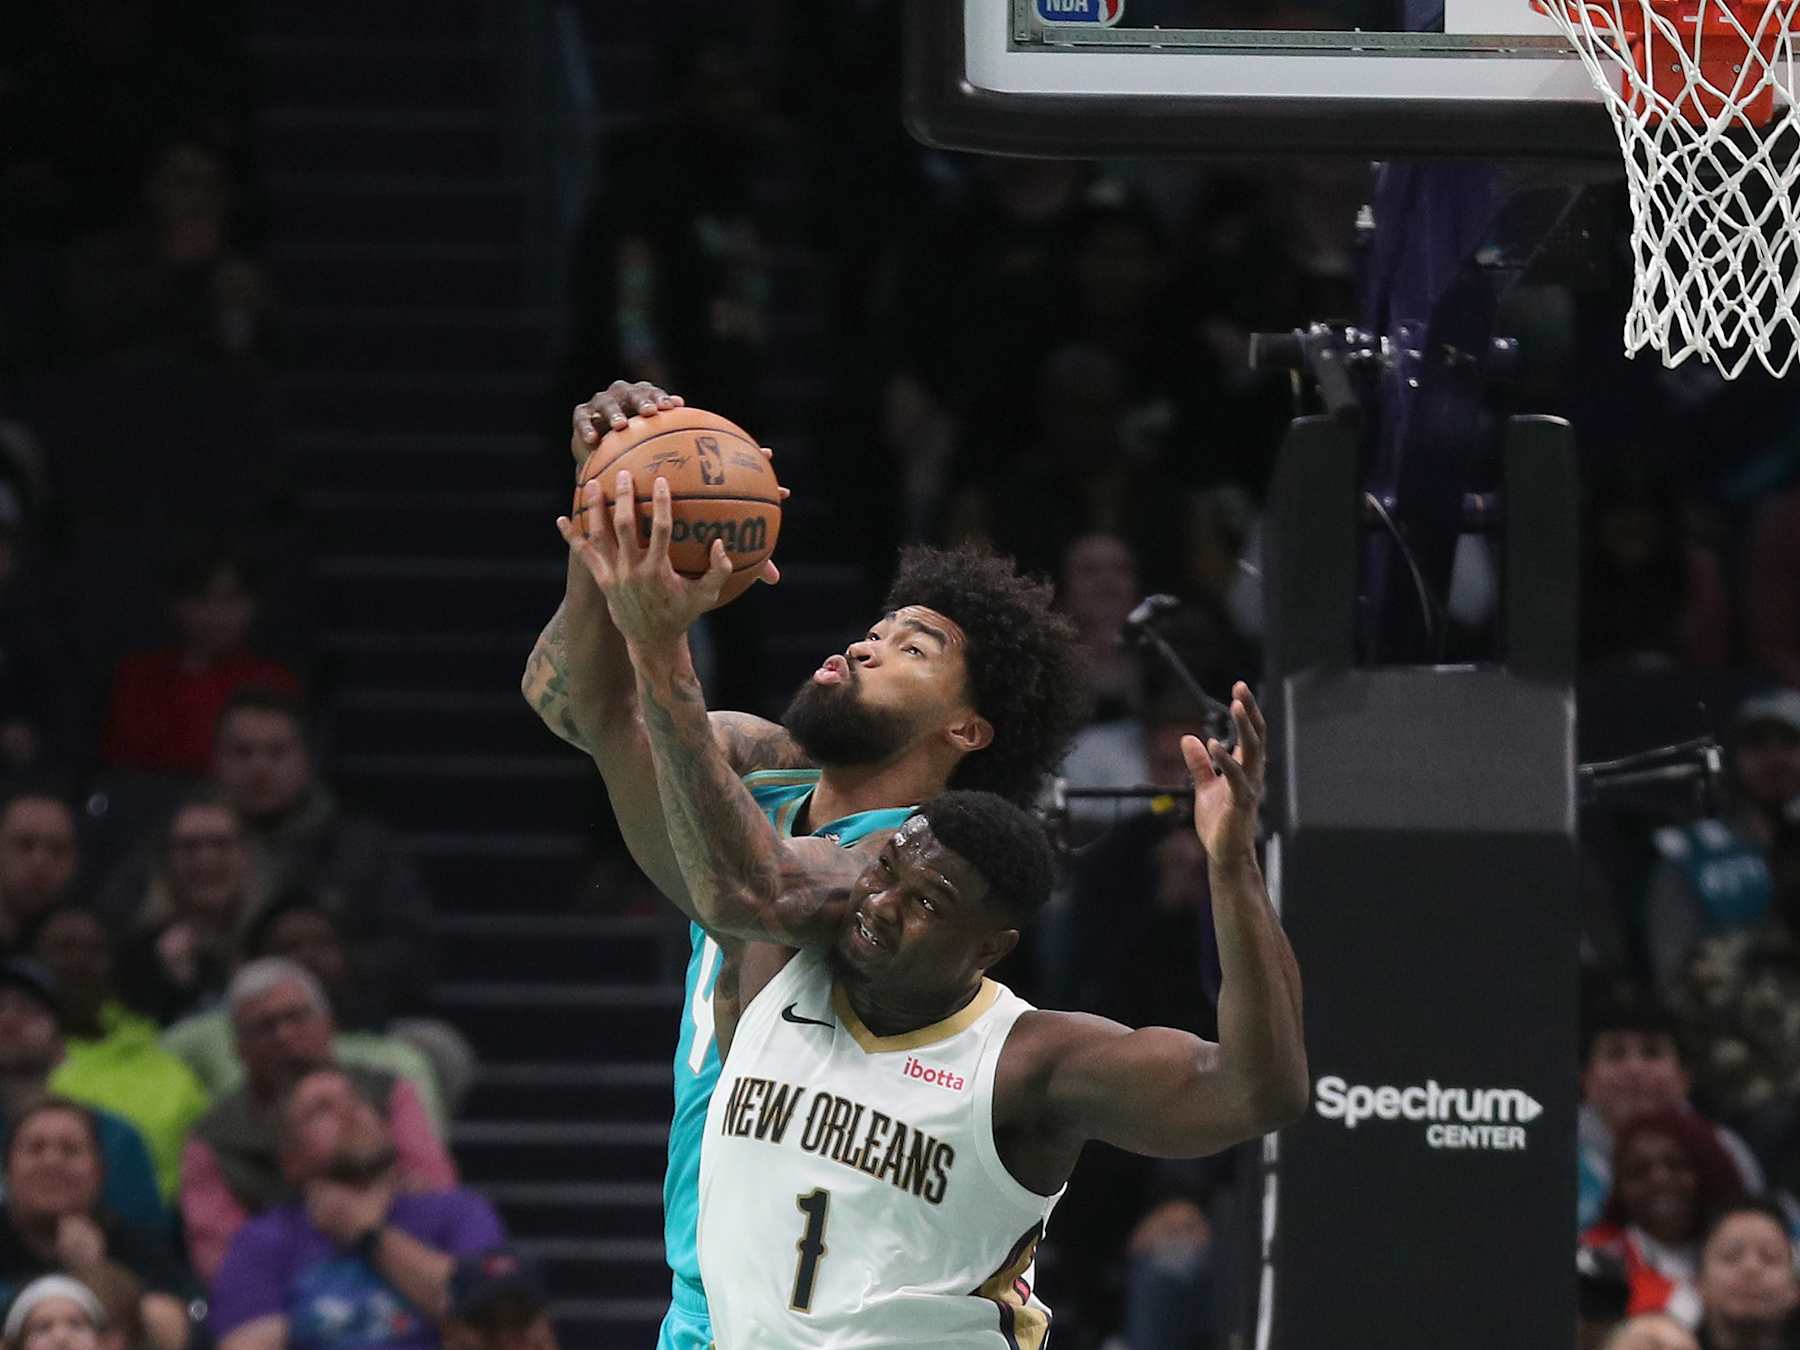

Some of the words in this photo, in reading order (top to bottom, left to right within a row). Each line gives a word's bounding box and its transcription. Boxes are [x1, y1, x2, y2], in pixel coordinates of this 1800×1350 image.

[903, 1056, 965, 1092] ibotta
[1315, 1075, 1533, 1129] Spectrum
[721, 1076, 805, 1145] NEW
[800, 1091, 955, 1205] ORLEANS
[1426, 1123, 1526, 1150] CENTER
[788, 1186, 833, 1315] 1
